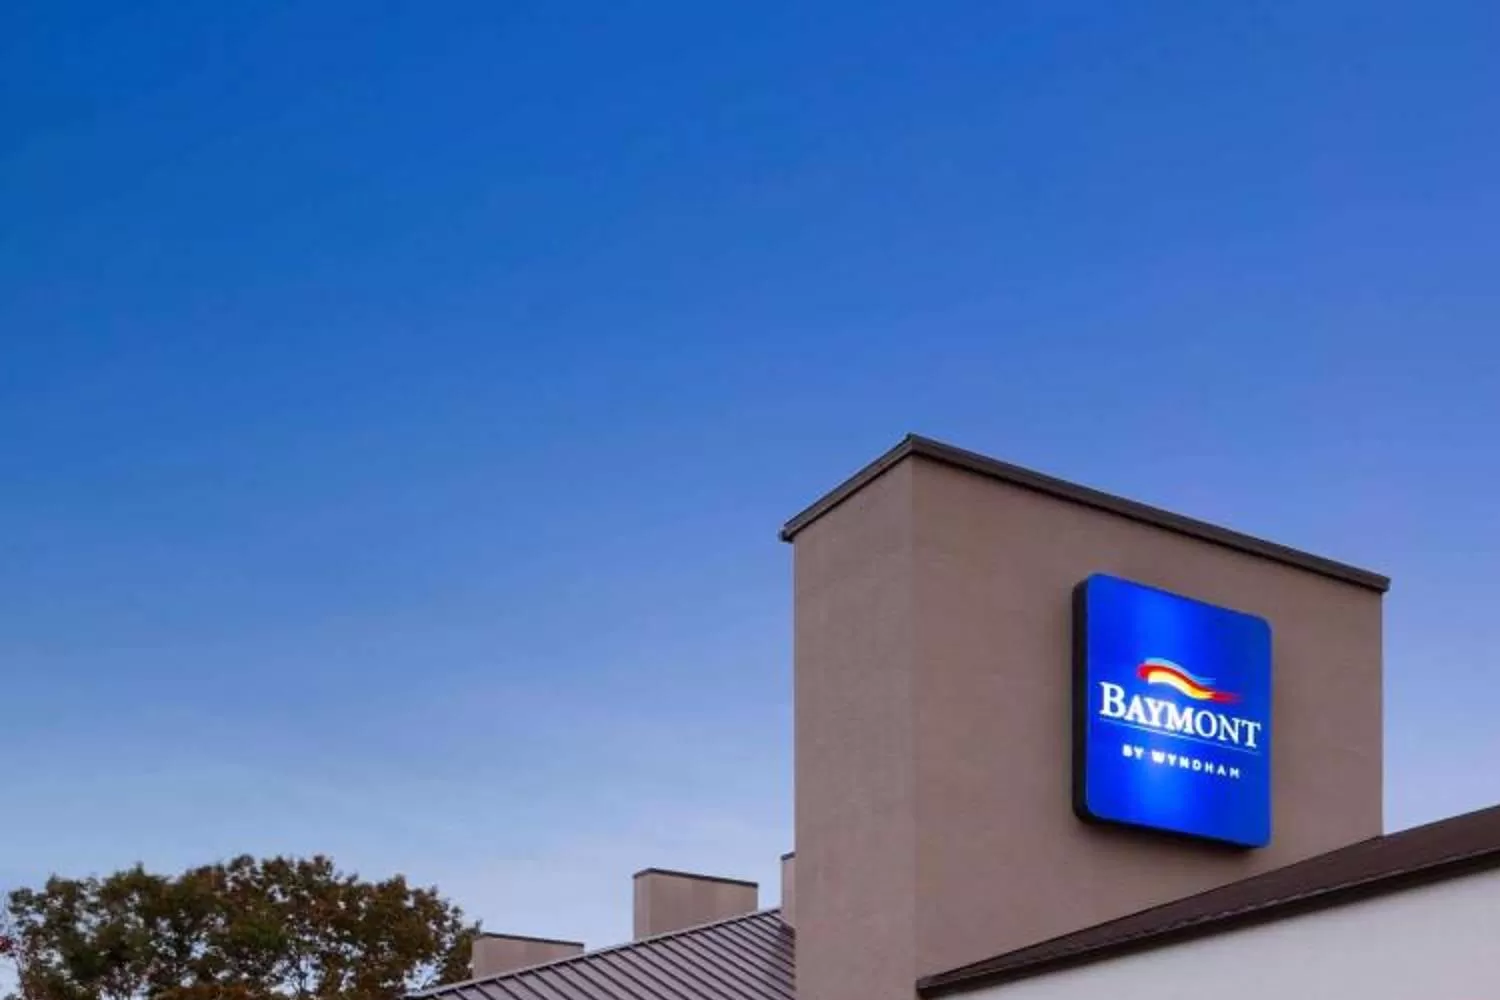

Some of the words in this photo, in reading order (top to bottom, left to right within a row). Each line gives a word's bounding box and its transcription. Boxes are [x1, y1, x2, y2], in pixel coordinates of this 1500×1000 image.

[1100, 681, 1261, 748] BAYMONT
[1122, 745, 1144, 759] BY
[1152, 749, 1240, 778] WYNDHAM
